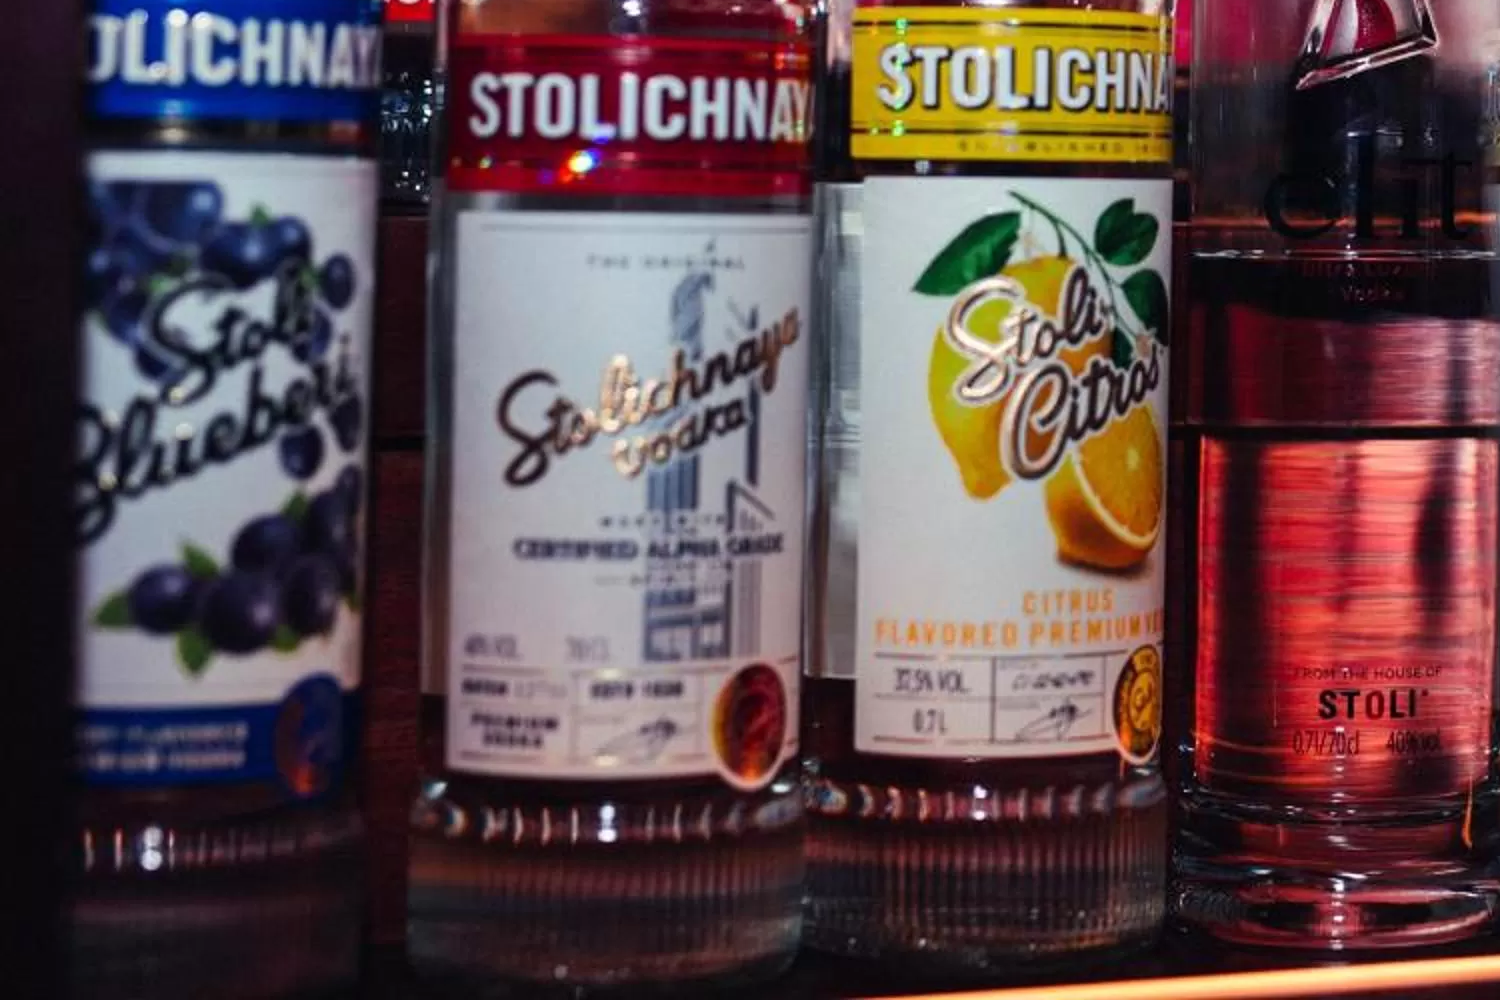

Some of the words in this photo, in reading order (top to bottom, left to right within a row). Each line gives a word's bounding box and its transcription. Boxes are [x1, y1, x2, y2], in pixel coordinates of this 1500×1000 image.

[947, 266, 1104, 402] Stoli
[1022, 588, 1114, 616] CITRUS
[874, 618, 1020, 648] FLAVORED
[1294, 666, 1336, 681] FROM
[1374, 666, 1423, 680] HOUSE
[1426, 666, 1442, 678] OF
[1318, 688, 1416, 720] STOLI
